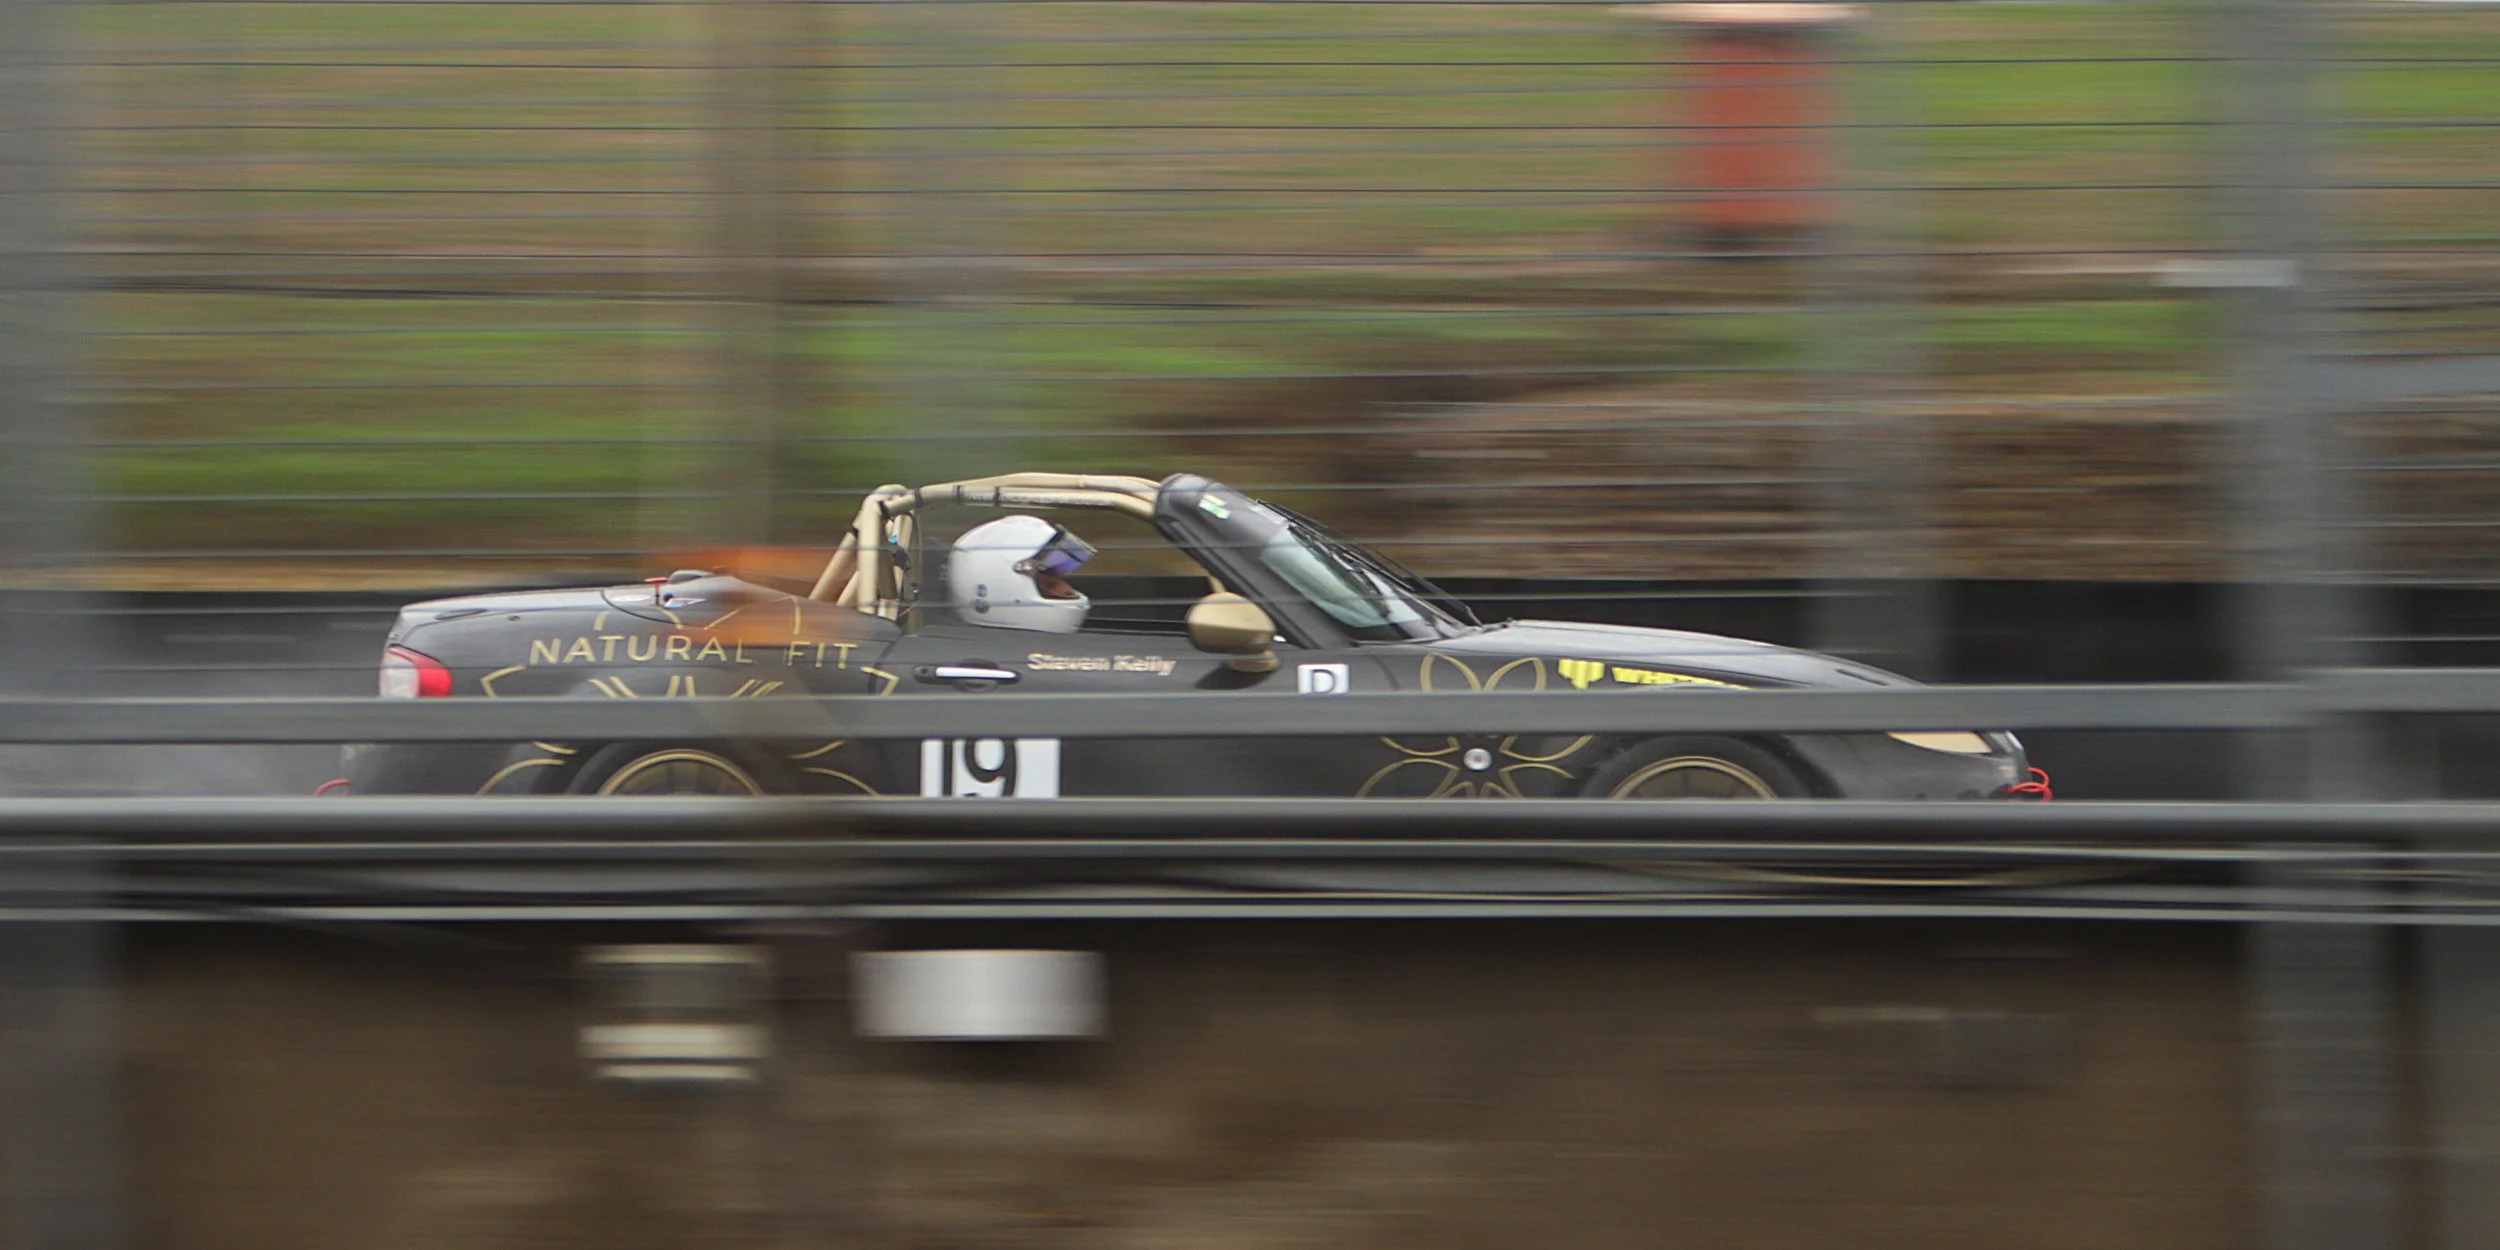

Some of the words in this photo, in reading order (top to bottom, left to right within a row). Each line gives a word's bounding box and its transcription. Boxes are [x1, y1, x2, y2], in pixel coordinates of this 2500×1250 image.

[529, 634, 755, 666] NATURAL
[784, 640, 858, 669] FIT
[941, 738, 1017, 797] 19
